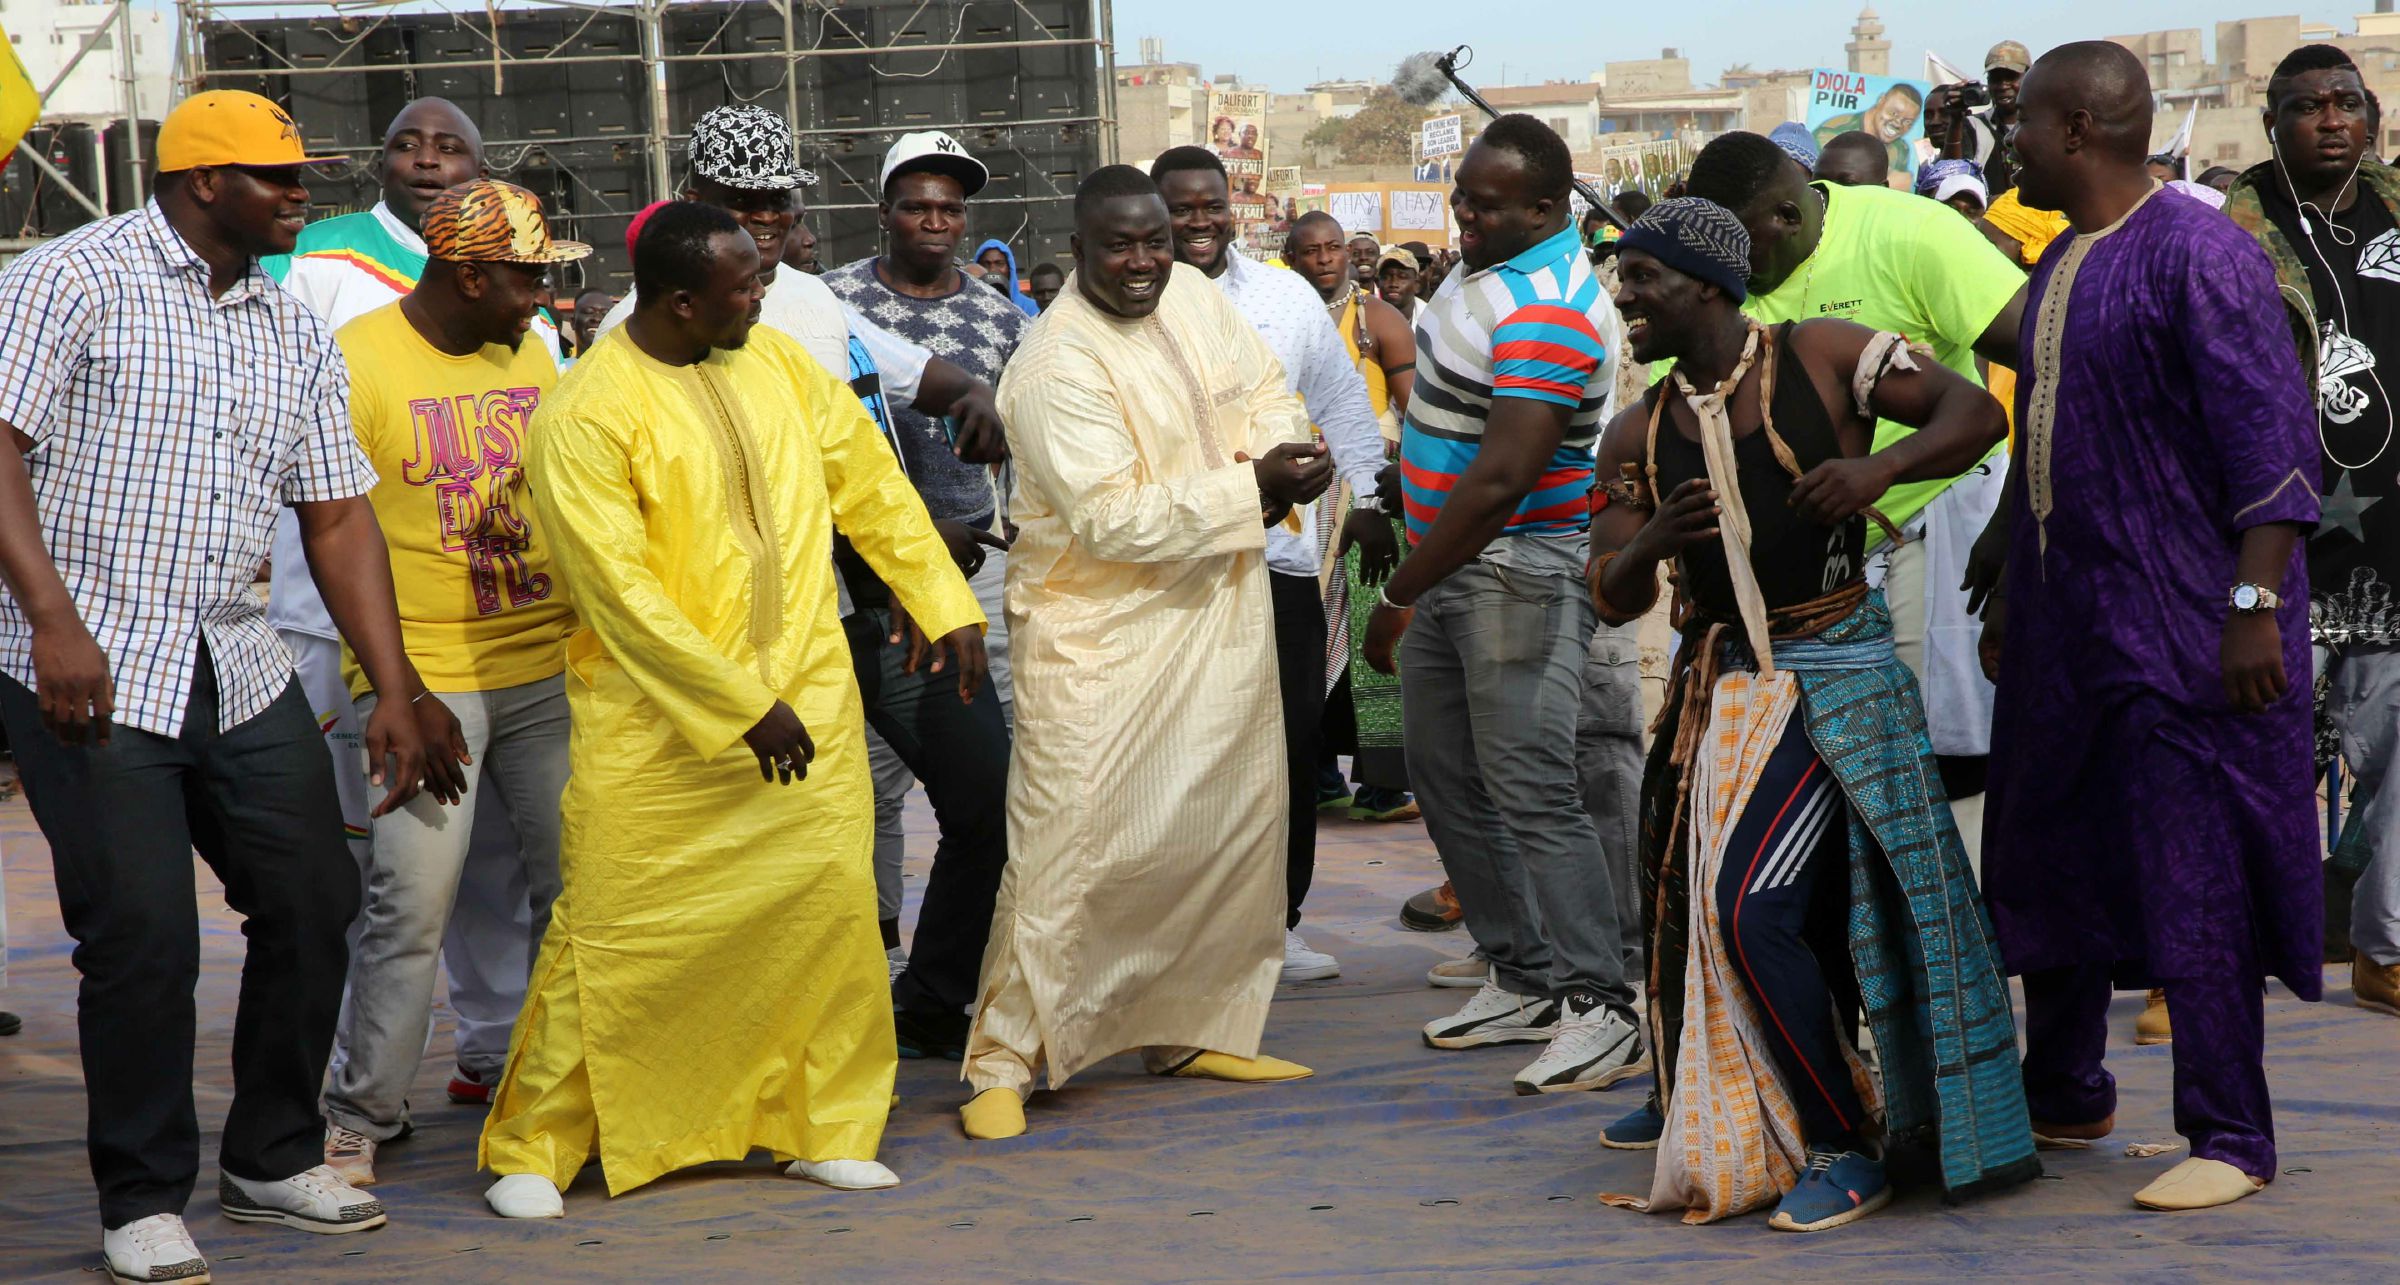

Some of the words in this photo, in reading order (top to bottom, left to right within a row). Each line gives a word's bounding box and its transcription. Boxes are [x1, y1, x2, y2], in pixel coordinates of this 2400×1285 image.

[1816, 71, 1866, 95] DIOLA
[1218, 93, 1258, 107] DALIFORT
[1816, 91, 1858, 110] PIIR
[1429, 128, 1454, 138] RECLAME
[1427, 139, 1436, 147] SON
[1438, 135, 1456, 144] LEADER
[1424, 146, 1444, 156] SAMBA
[1268, 169, 1294, 182] LIFORT
[1331, 192, 1381, 216] KHAYA
[402, 387, 540, 486] JUST
[1574, 991, 1593, 1004] FILA
